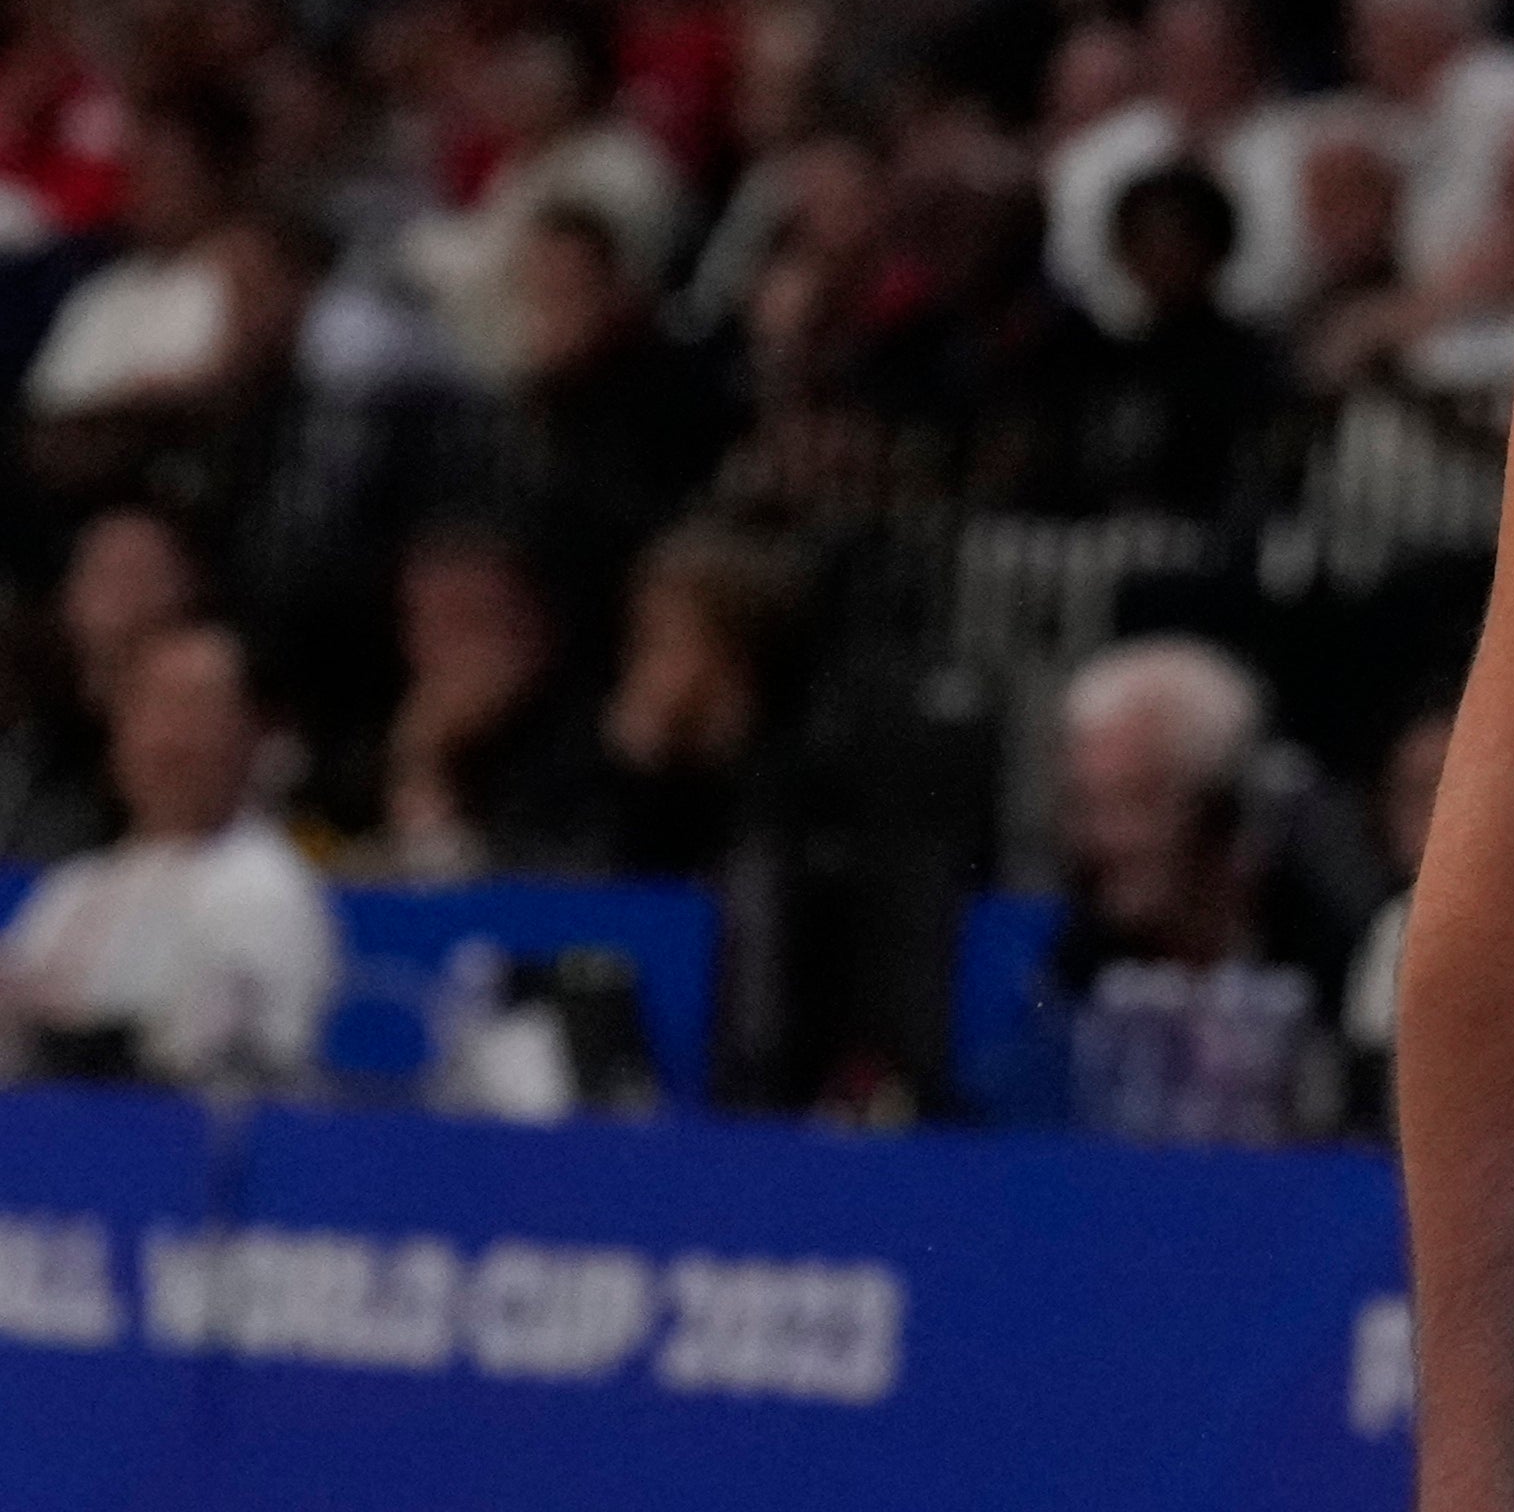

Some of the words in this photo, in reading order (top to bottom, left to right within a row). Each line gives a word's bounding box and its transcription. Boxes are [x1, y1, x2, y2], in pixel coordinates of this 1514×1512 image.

[143, 1220, 457, 1370] WORLD
[470, 1236, 652, 1382] CUP
[655, 1250, 906, 1405] 2023
